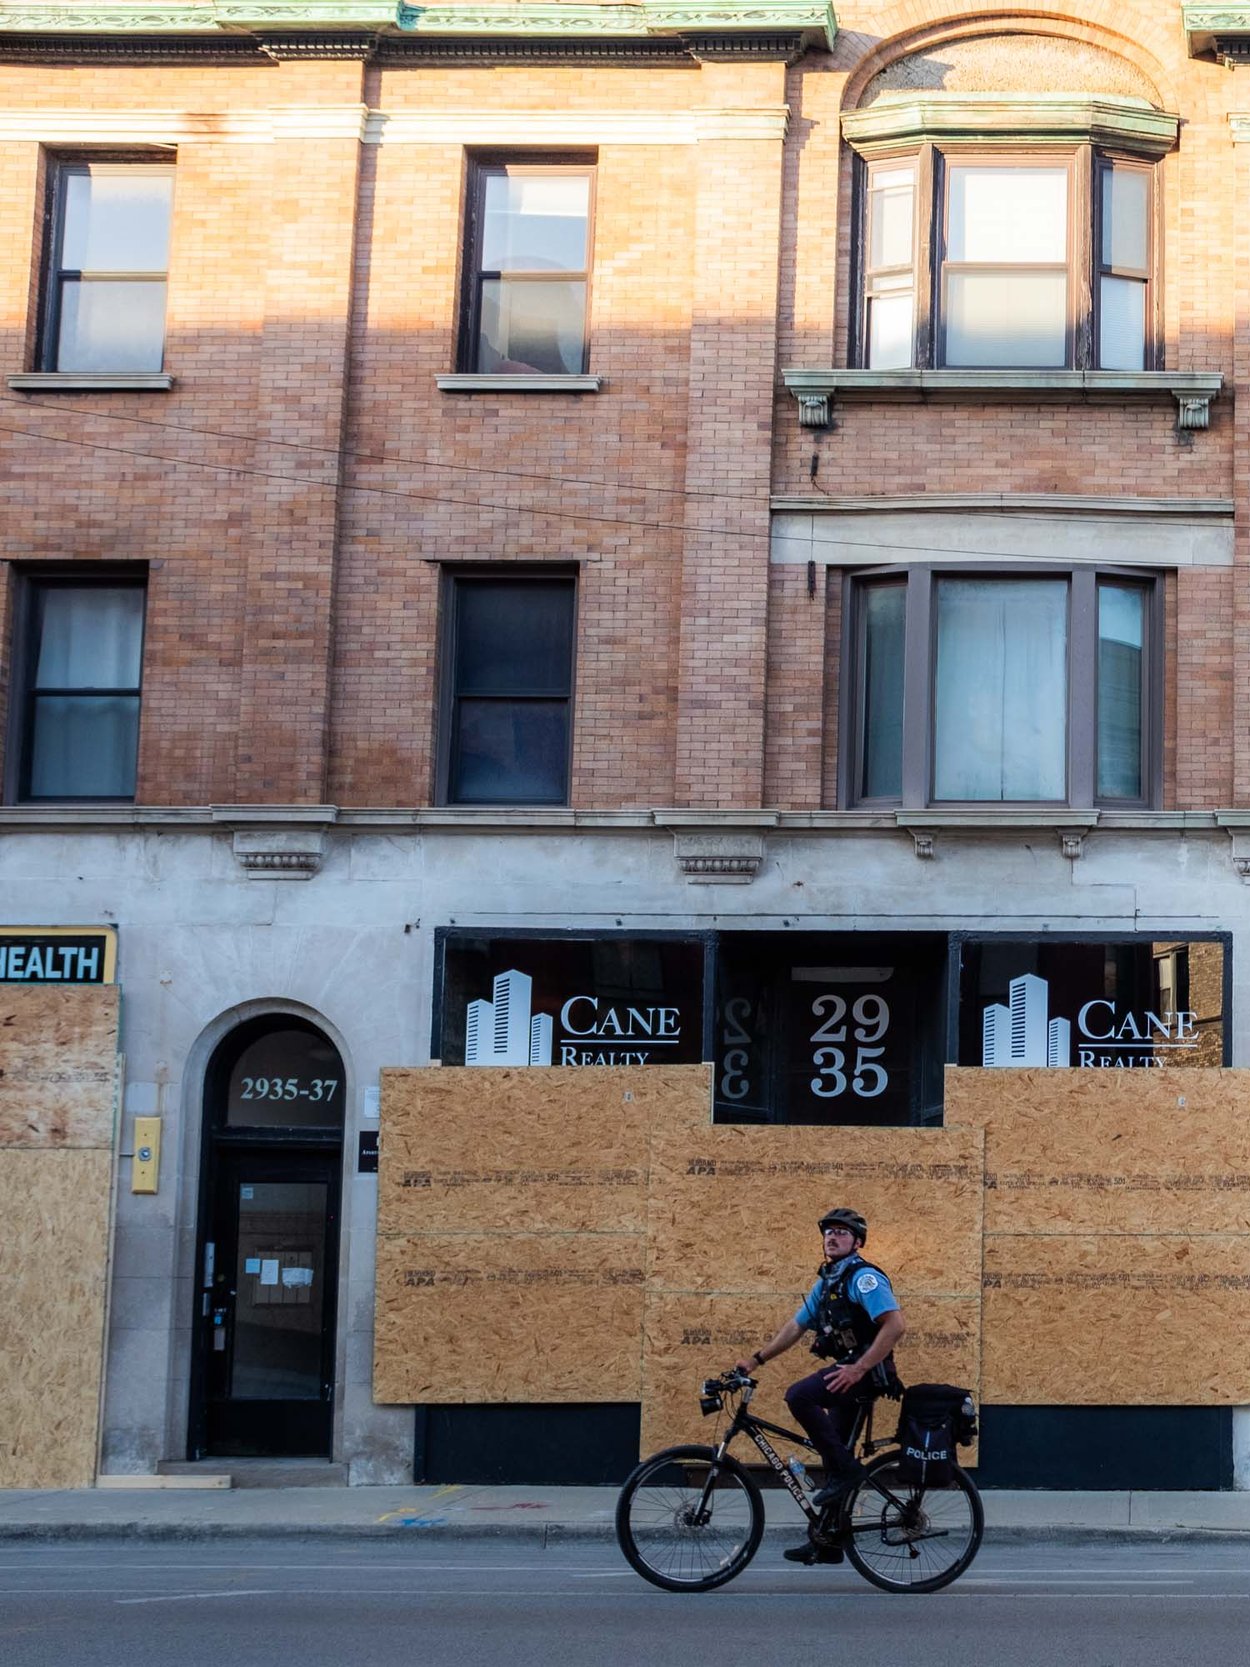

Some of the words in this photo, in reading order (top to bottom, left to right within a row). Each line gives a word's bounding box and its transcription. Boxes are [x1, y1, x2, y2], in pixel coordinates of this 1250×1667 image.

[560, 995, 681, 1036] CANE
[810, 994, 890, 1042] 29
[1078, 1000, 1199, 1040] CANE
[560, 1046, 649, 1066] REALTY
[810, 1046, 889, 1098] 35
[240, 1077, 338, 1101] 2935-37
[754, 1434, 784, 1470] CHICAGO
[780, 1470, 806, 1502] POLICE
[906, 1446, 948, 1460] POLICE
